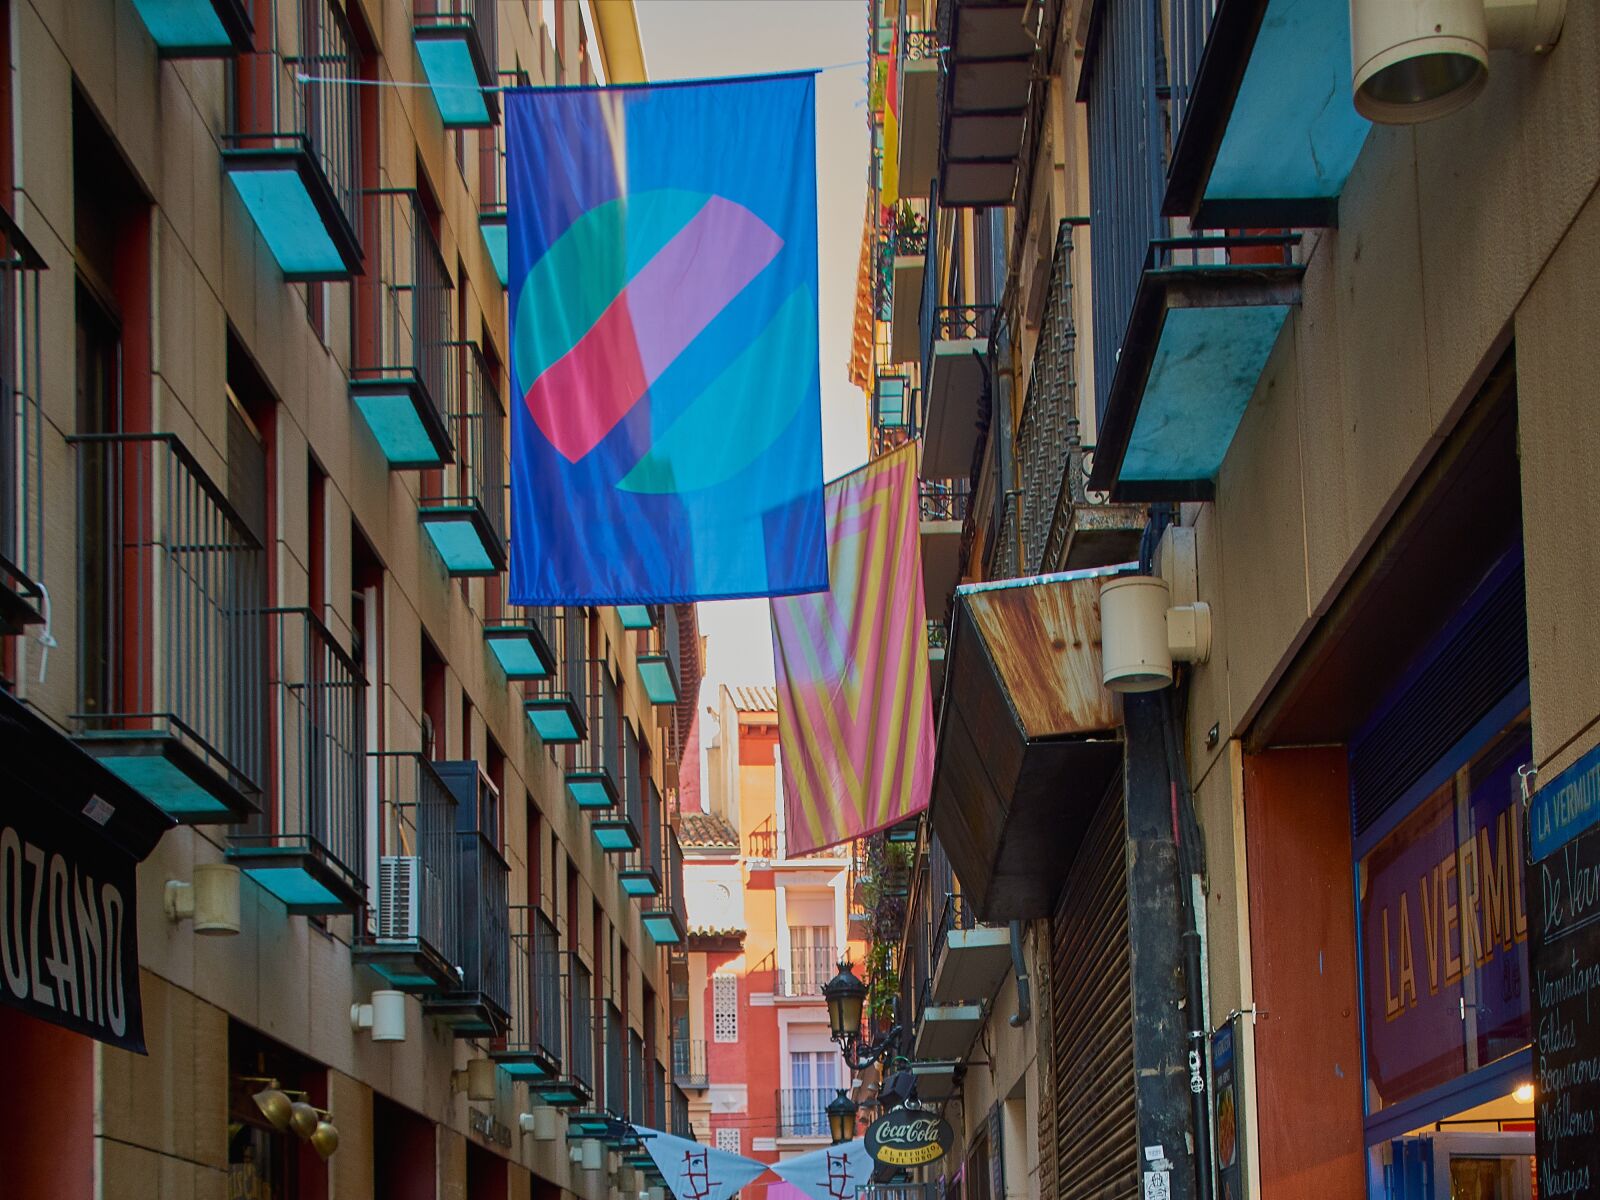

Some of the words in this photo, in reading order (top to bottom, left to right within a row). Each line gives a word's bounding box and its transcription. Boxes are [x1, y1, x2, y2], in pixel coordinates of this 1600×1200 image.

[1538, 800, 1551, 841] LA
[0, 825, 127, 1038] OZANO
[1542, 864, 1564, 935] De
[1382, 890, 1417, 1022] LA
[1539, 1007, 1576, 1054] Gildas
[875, 1119, 941, 1143] Coca-Cola
[1541, 1092, 1594, 1169] Mejillones
